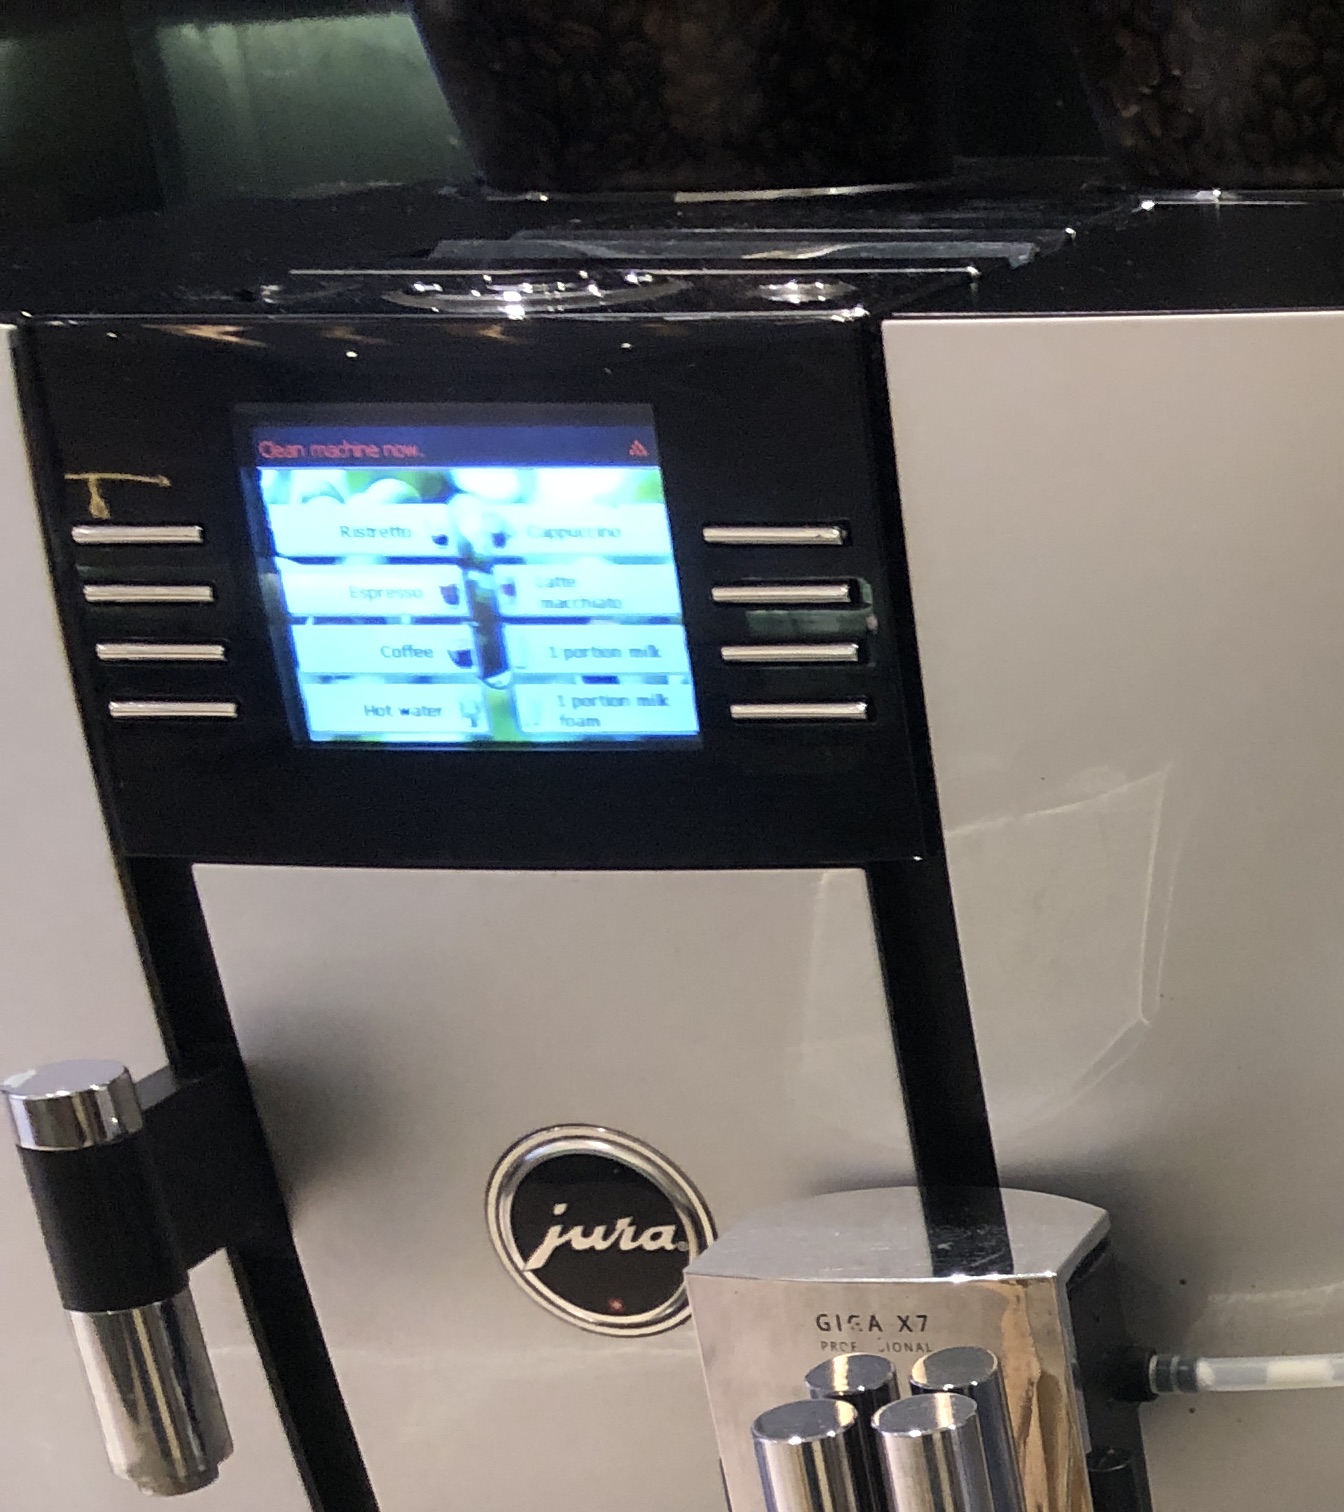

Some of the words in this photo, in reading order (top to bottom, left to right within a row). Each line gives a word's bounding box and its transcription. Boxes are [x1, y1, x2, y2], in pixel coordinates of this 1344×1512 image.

[258, 439, 305, 461] Clean
[309, 439, 379, 461] machine
[339, 524, 412, 541] Ristretto
[535, 573, 577, 592] Latte
[348, 583, 424, 604] Espresso
[540, 593, 623, 612] macchiato
[379, 643, 435, 661] Coffee
[564, 643, 624, 663] portion
[629, 643, 662, 661] milk
[363, 702, 394, 719] Hot
[399, 703, 443, 719] water
[571, 693, 629, 712] portion
[635, 692, 670, 708] milk
[558, 713, 602, 729] foam
[522, 1202, 677, 1271] jura
[896, 1314, 929, 1333] X7
[819, 1340, 933, 1353] PROFIONAL
